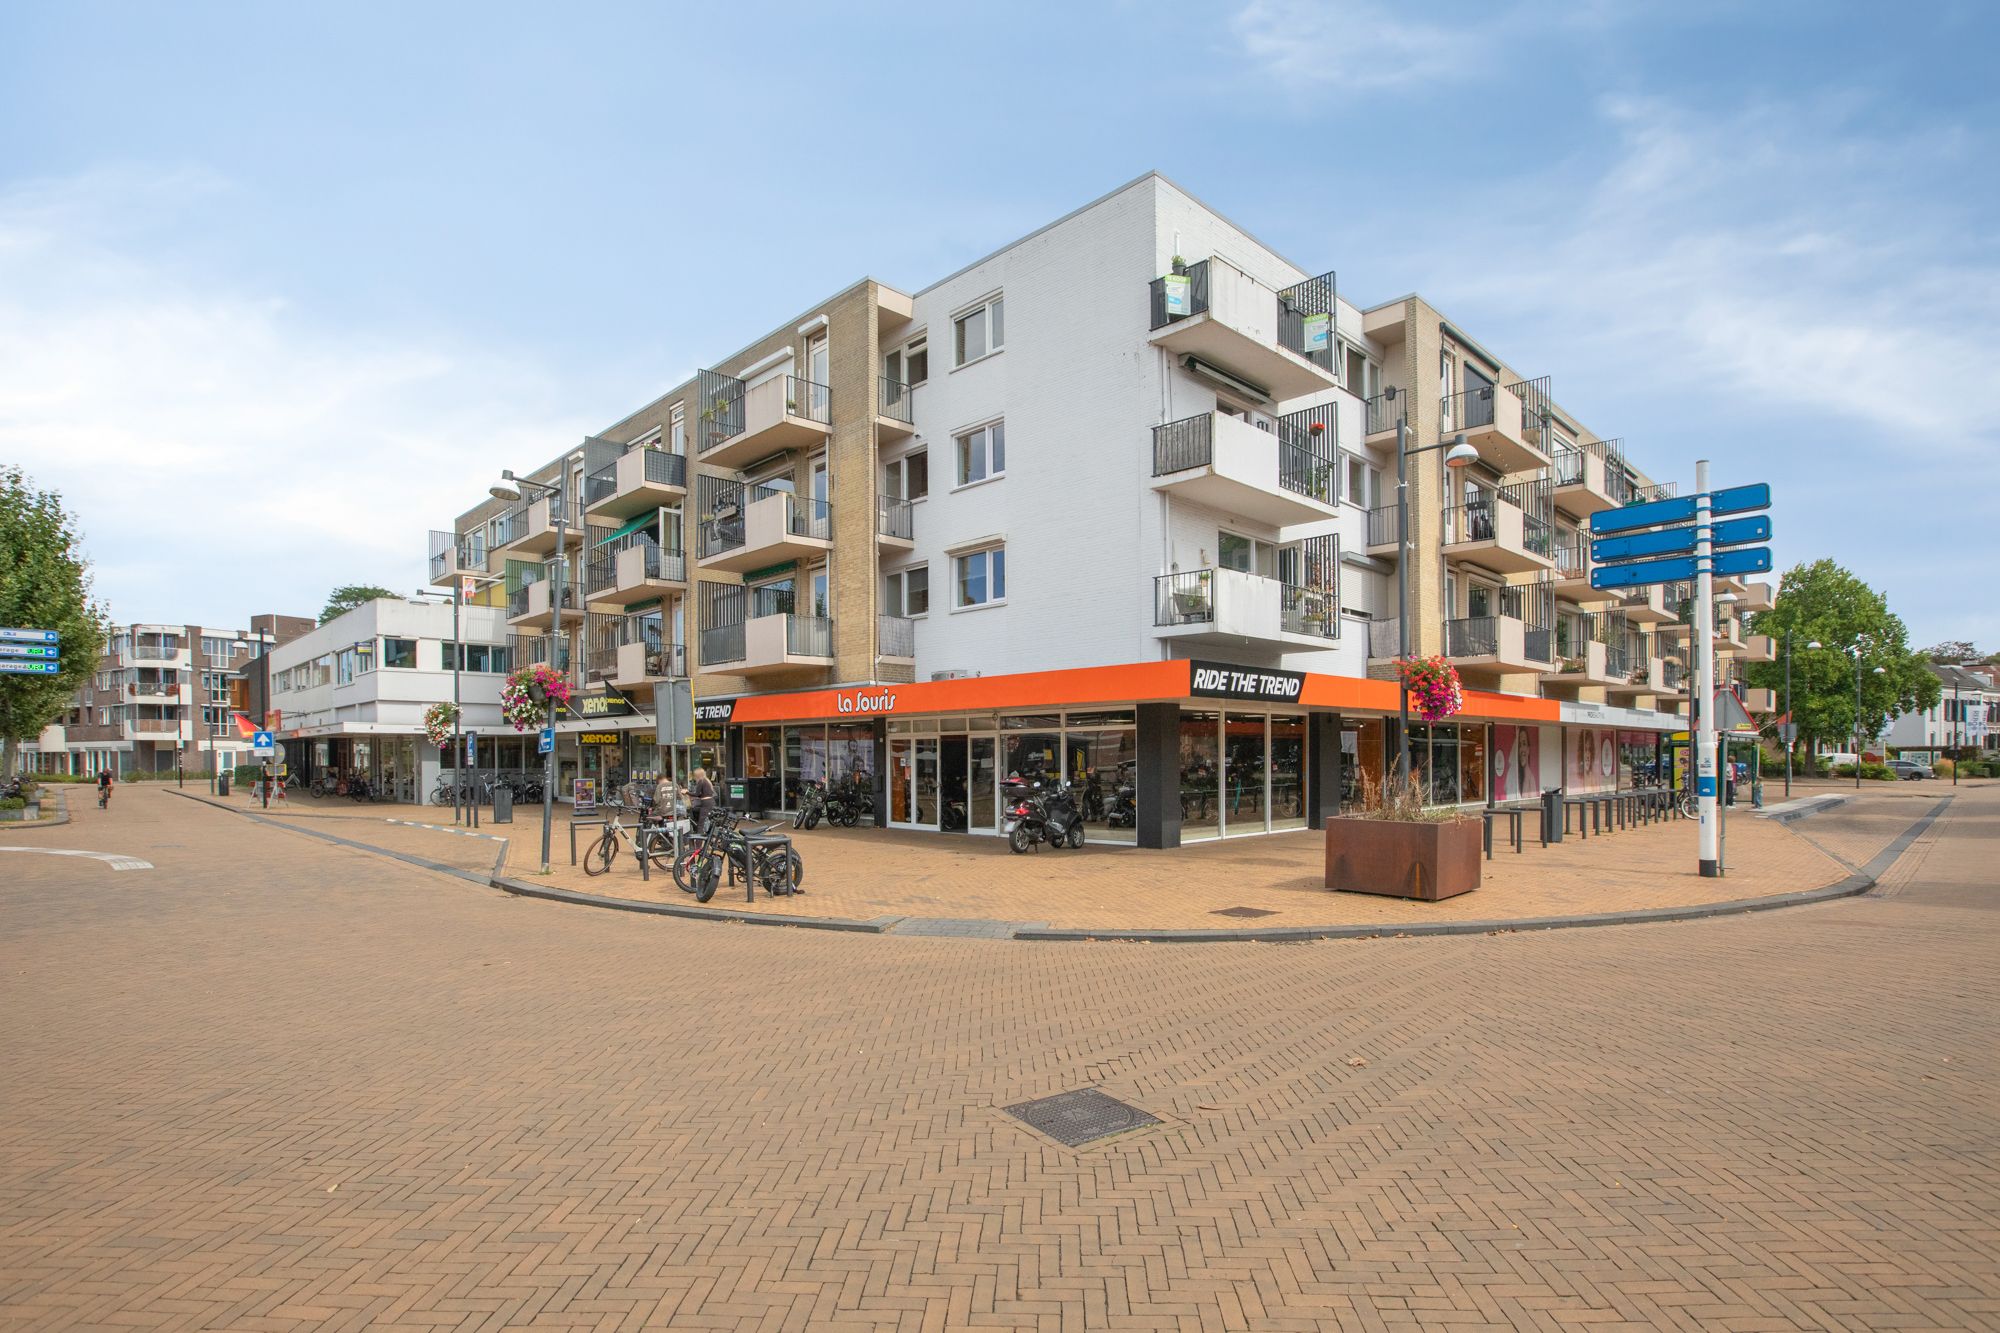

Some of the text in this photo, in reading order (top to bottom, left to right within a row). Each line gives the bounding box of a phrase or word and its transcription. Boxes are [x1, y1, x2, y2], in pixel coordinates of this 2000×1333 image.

[1193, 668, 1300, 696] RIDE THE TREND
[855, 688, 896, 712] Souris
[694, 704, 732, 719] HE TREND
[581, 733, 618, 743] xenos
[696, 729, 721, 740] nos
